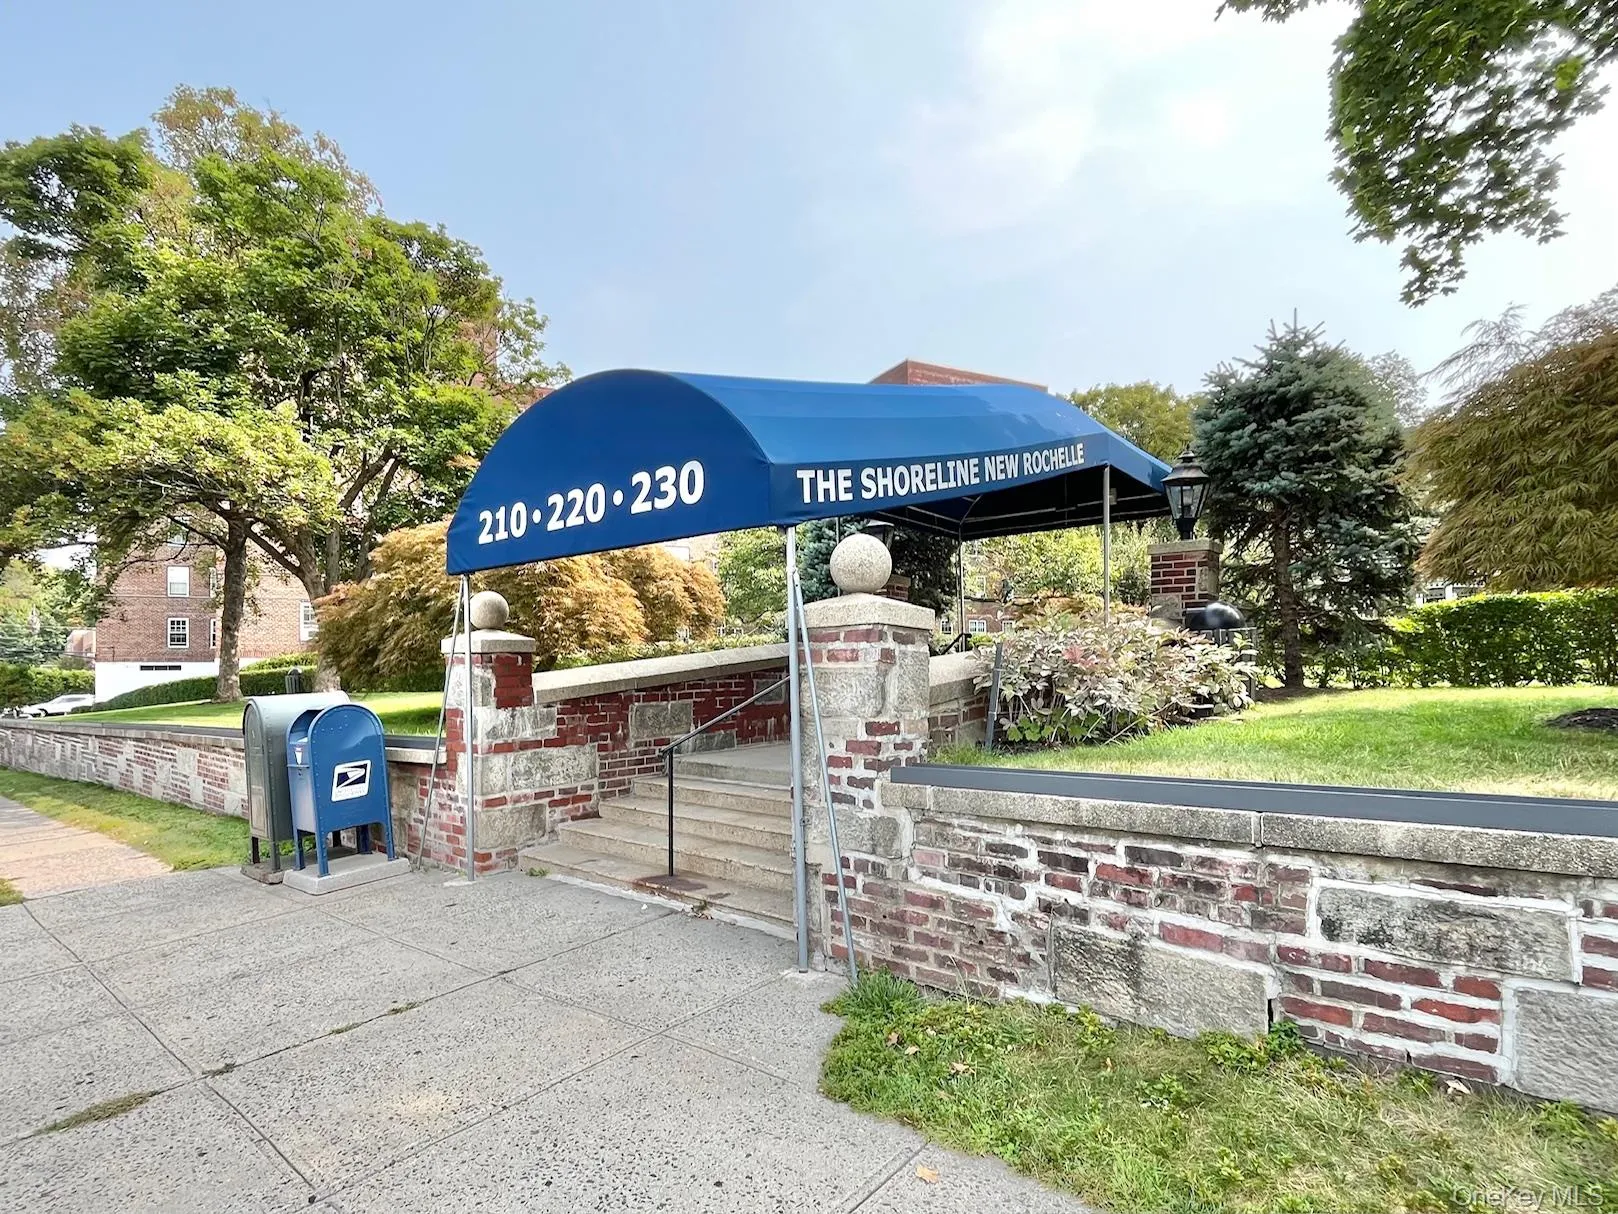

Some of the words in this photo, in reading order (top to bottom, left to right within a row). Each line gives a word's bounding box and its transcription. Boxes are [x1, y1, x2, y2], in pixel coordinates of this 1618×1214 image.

[797, 468, 854, 504] THE
[860, 457, 980, 500] SHORELINE
[984, 453, 1019, 482] NEW
[1023, 442, 1085, 475] ROCHELLE
